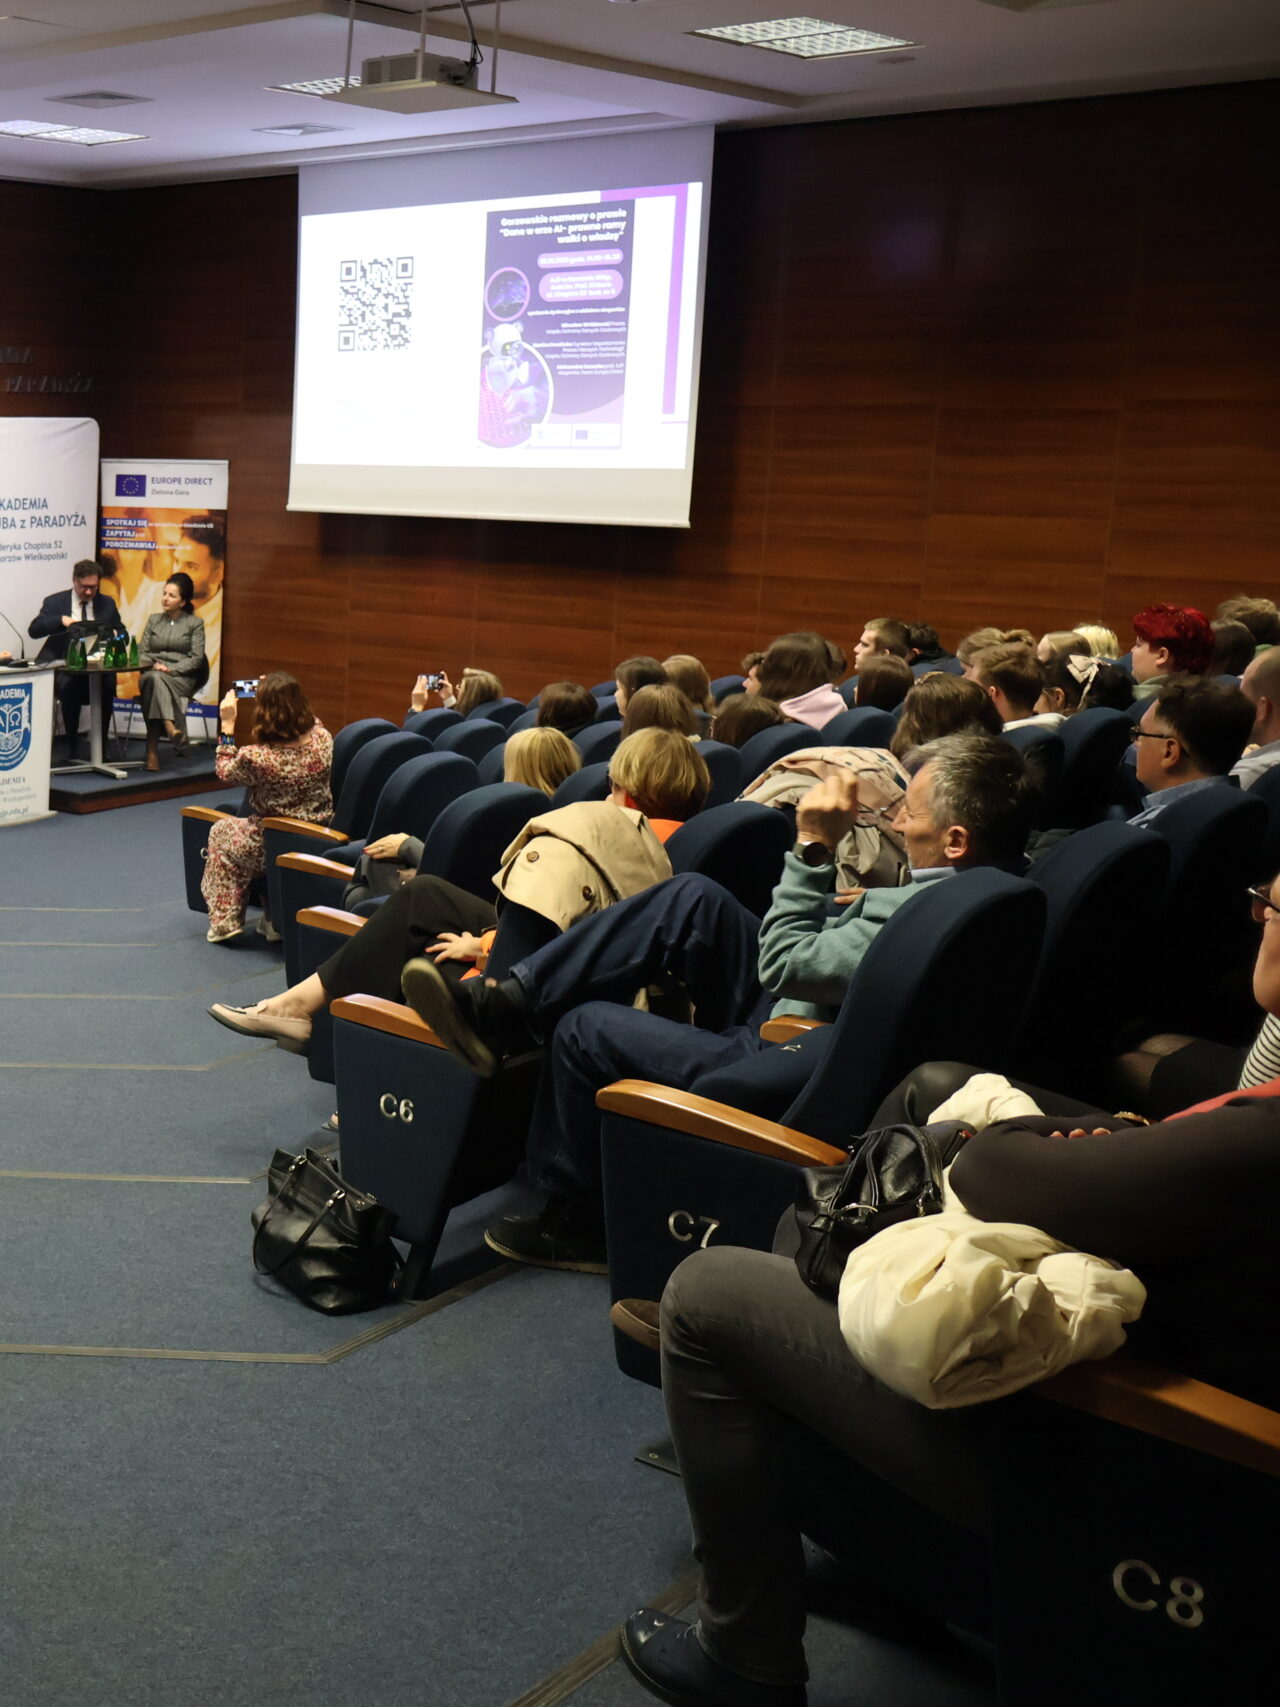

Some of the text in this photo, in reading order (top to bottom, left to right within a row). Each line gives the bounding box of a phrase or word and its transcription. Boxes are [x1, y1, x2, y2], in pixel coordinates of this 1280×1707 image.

[20, 520, 26, 528] z
[30, 512, 86, 528] PARADYŻA
[24, 542, 52, 552] Chopina
[24, 552, 68, 562] Wielkopolski
[380, 1092, 414, 1123] C6
[668, 1210, 720, 1249] C7
[1112, 1559, 1205, 1628] C8
